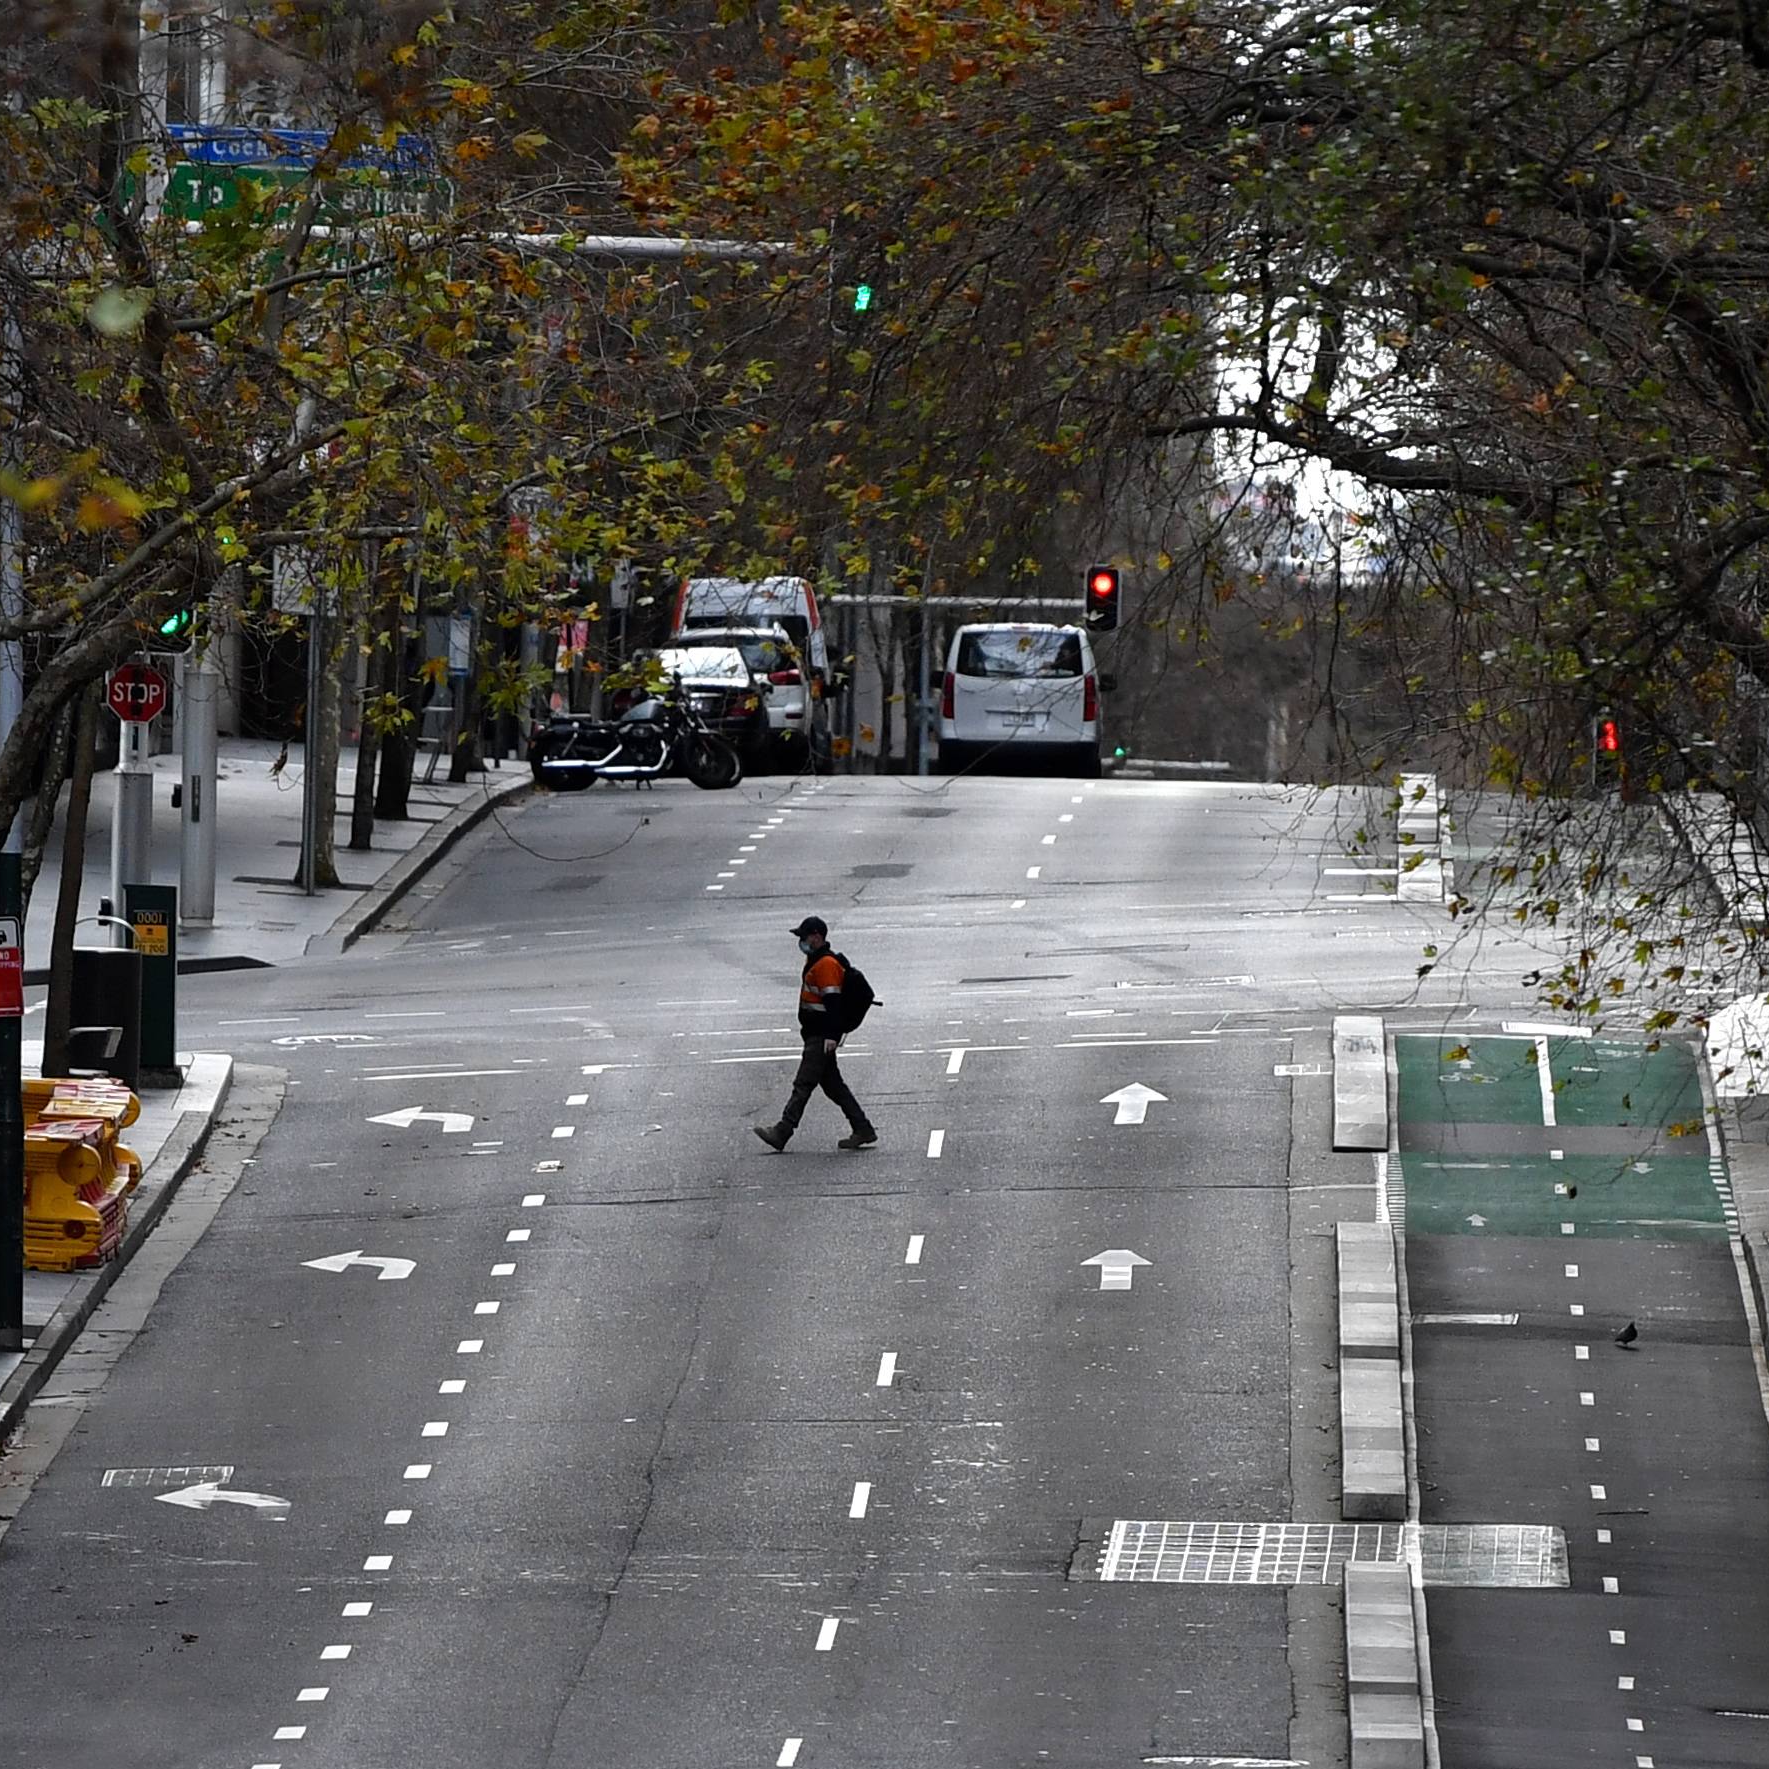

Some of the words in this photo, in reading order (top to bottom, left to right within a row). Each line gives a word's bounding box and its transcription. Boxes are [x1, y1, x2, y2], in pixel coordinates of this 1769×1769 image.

[113, 682, 161, 704] STOP
[137, 912, 162, 923] 0001
[0, 951, 9, 960] NO
